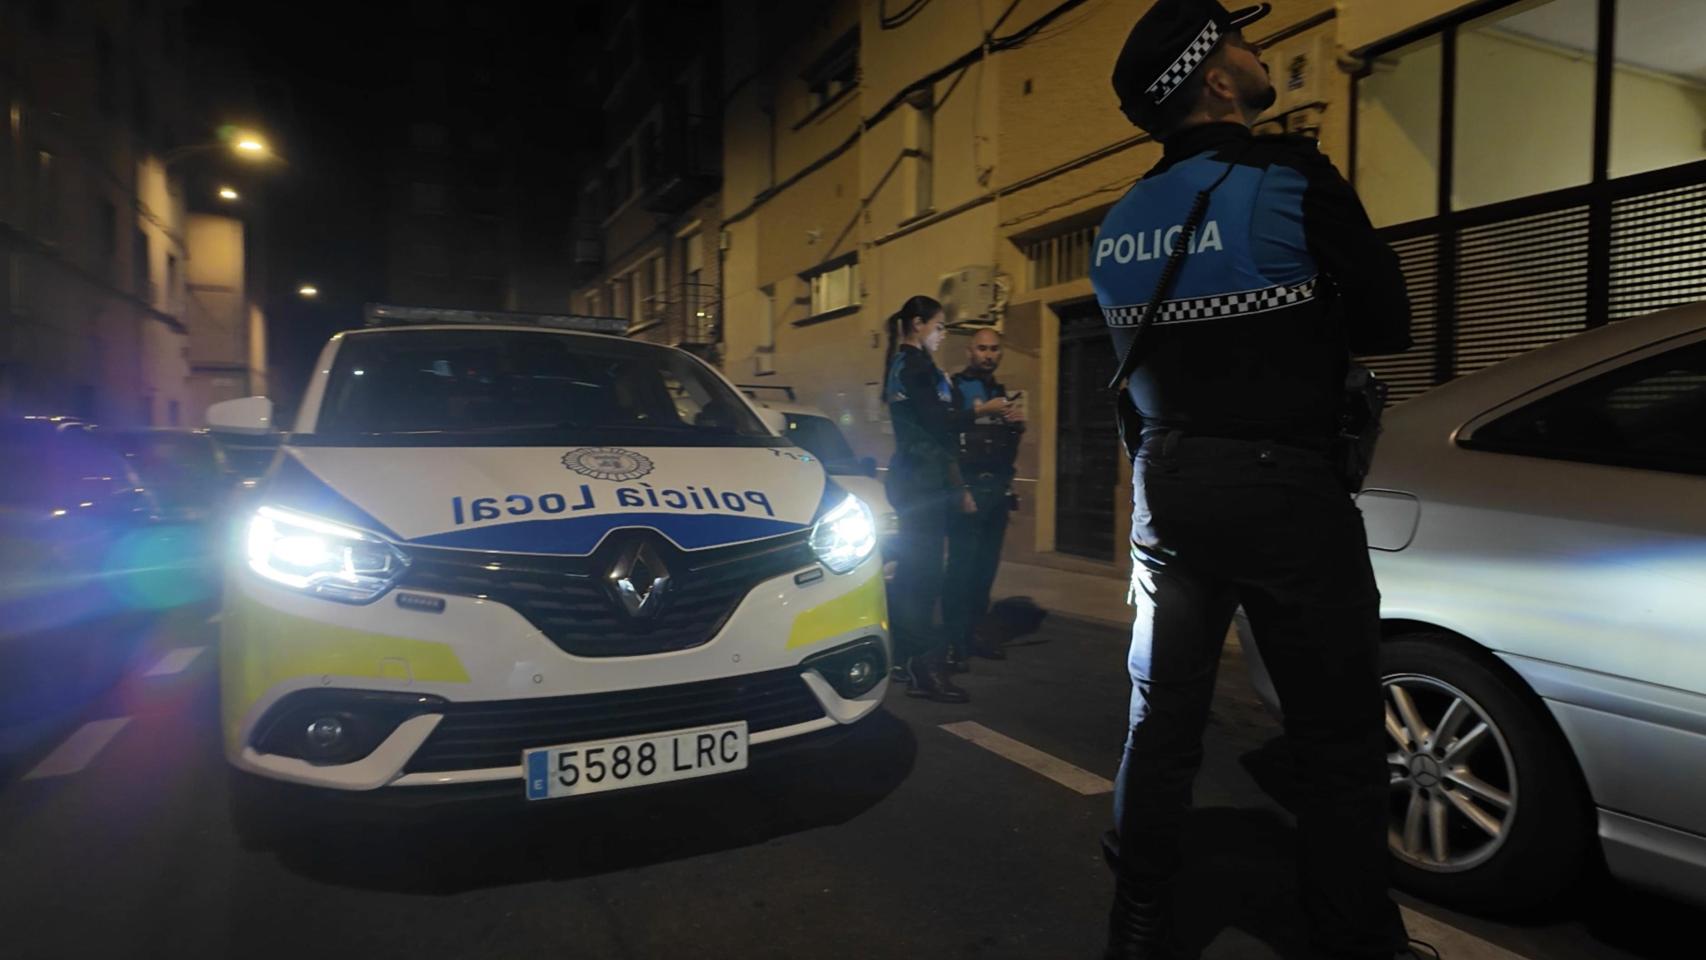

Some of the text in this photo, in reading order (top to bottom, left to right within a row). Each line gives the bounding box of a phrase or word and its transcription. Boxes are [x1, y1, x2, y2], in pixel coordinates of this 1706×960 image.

[558, 730, 738, 787] 5588 LRC
[533, 779, 543, 790] E
